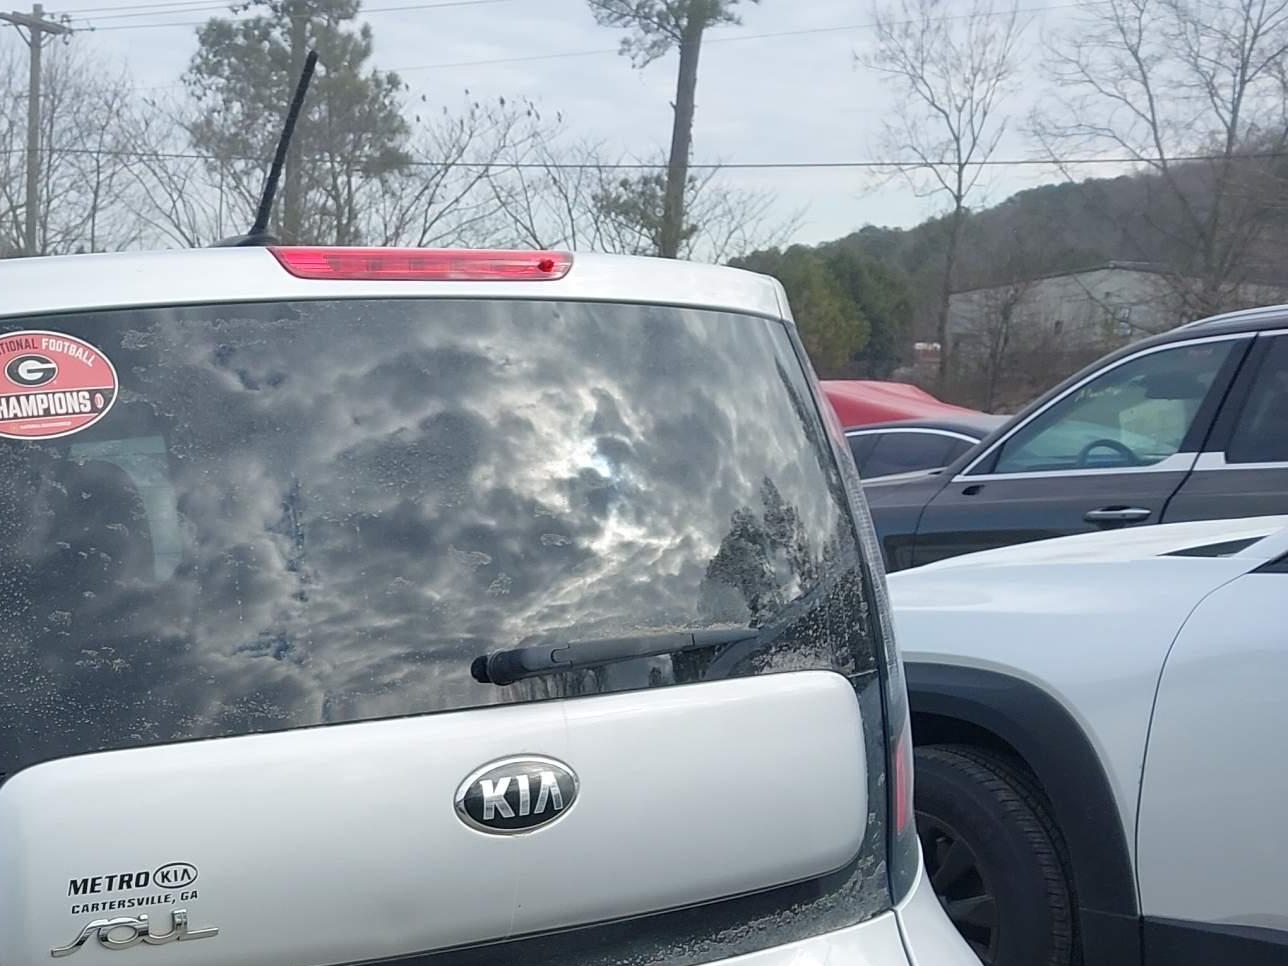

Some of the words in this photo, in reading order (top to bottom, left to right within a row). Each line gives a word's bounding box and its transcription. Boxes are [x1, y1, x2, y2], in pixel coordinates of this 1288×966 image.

[41, 338, 96, 368] FOOTBALL
[6, 354, 58, 387] G
[478, 771, 563, 820] KIA
[67, 871, 150, 897] METRO
[71, 894, 176, 915] CARTERSVILLE,
[180, 890, 199, 901] GA
